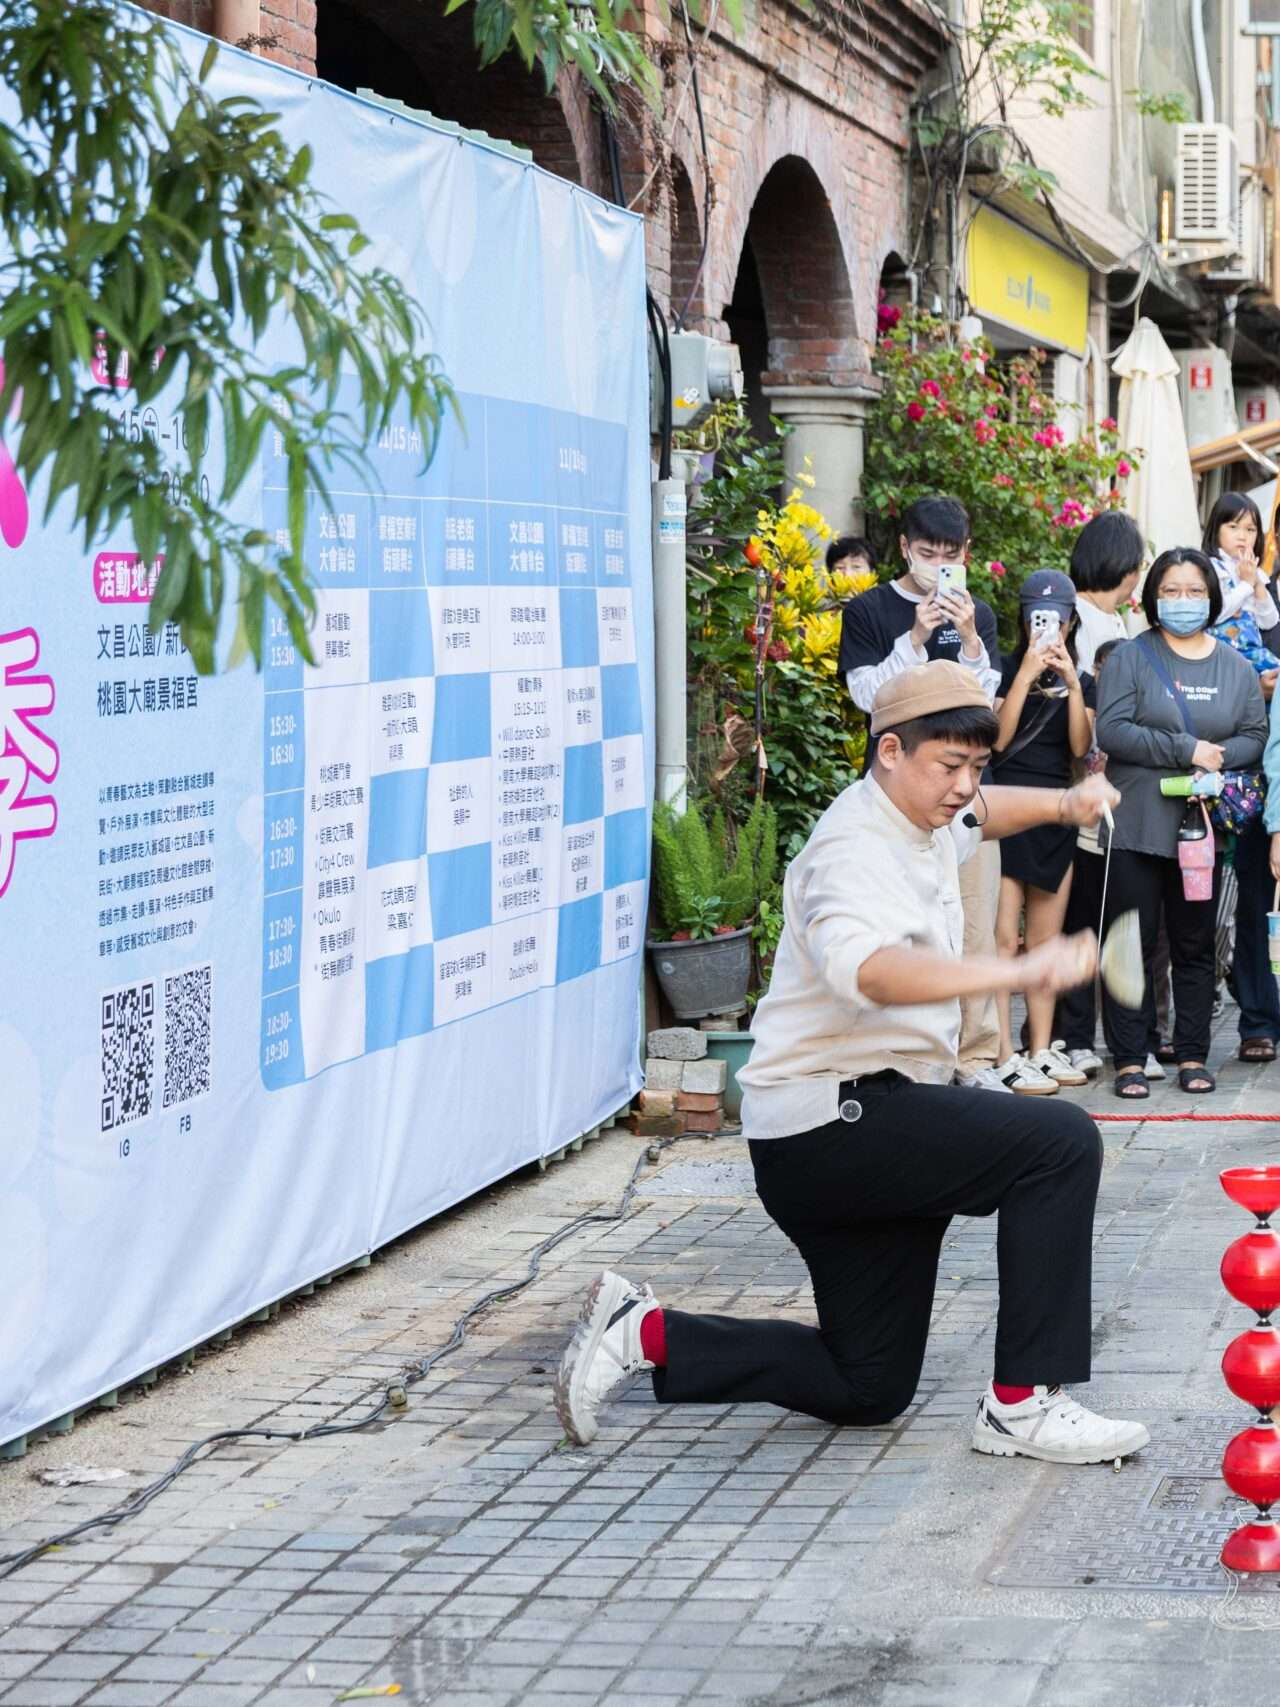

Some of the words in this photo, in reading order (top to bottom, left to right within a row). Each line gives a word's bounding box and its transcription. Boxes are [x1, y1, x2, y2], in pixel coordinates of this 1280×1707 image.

[97, 674, 199, 718] 桃園大廟景福宮
[179, 1116, 191, 1134] FB
[119, 1138, 131, 1158] IG
